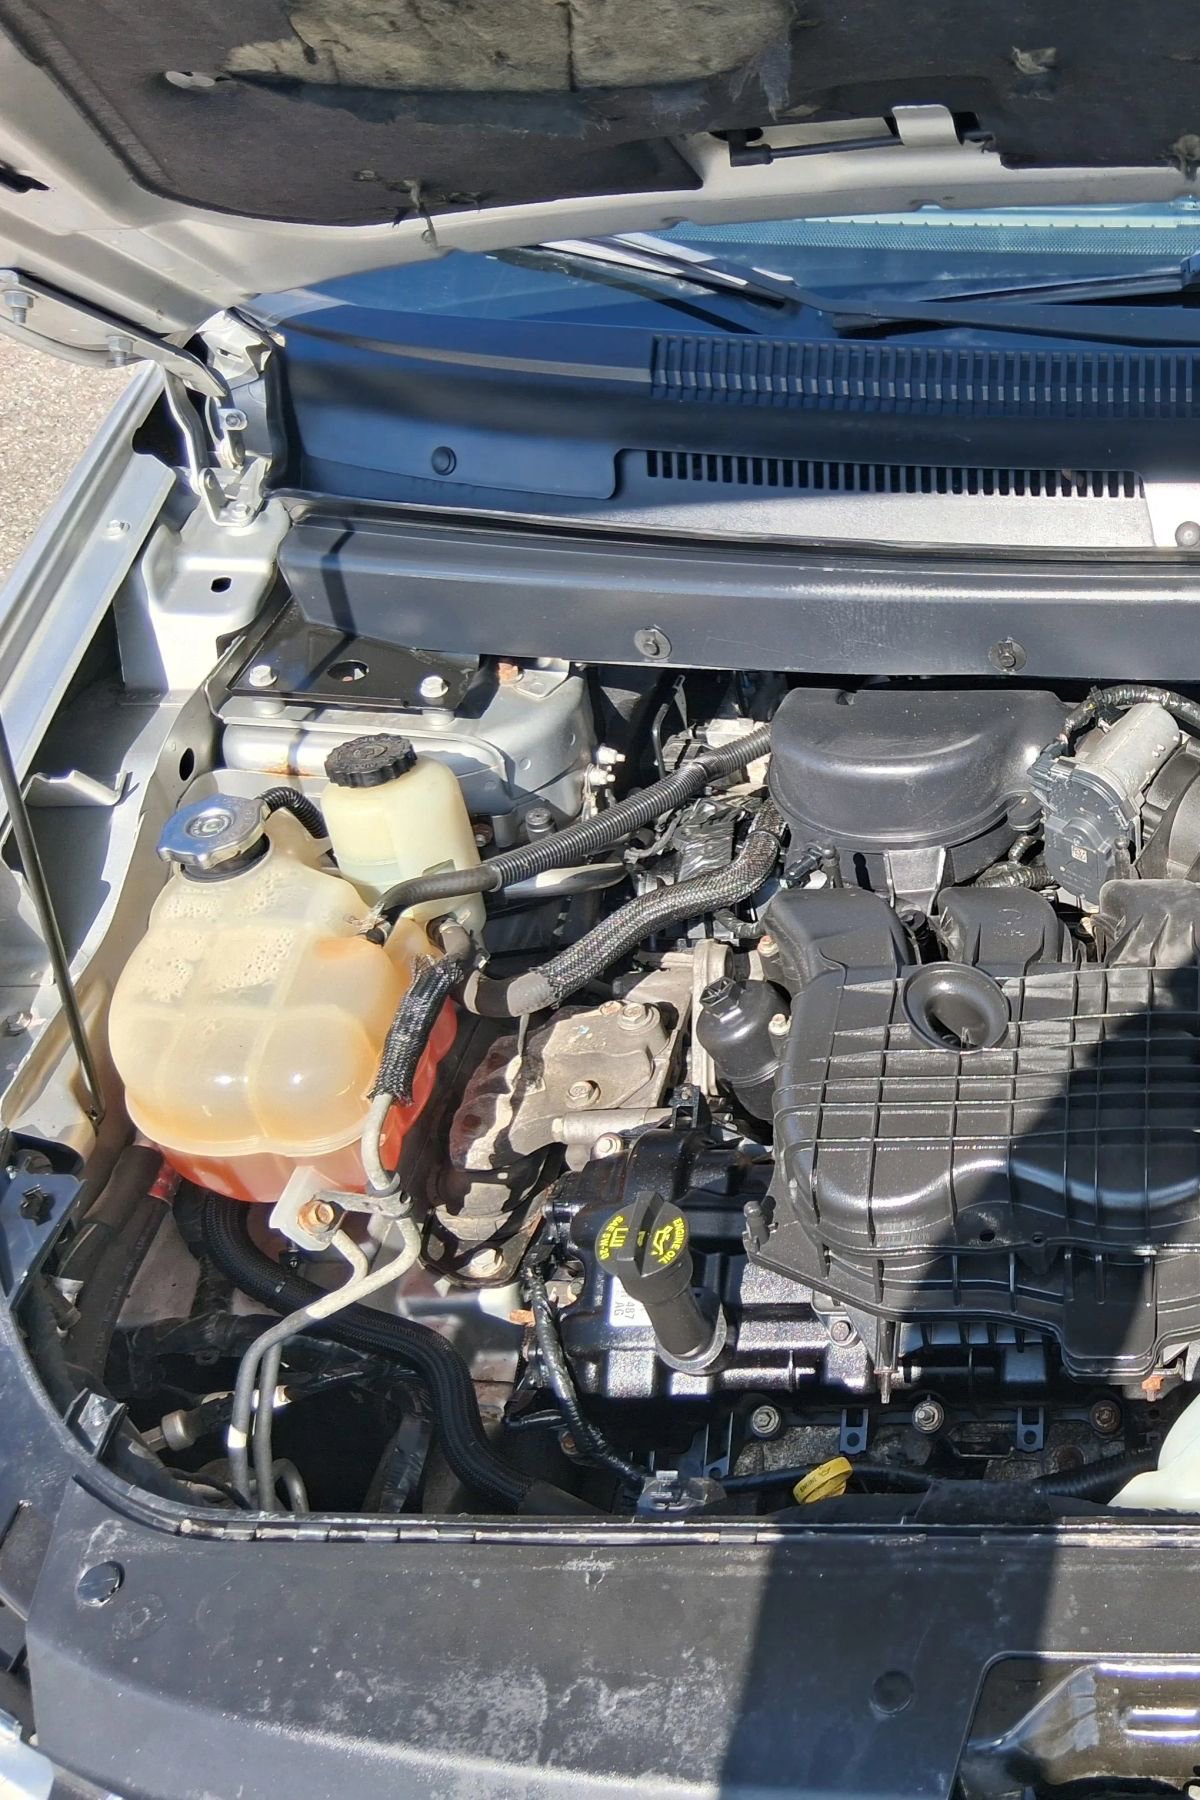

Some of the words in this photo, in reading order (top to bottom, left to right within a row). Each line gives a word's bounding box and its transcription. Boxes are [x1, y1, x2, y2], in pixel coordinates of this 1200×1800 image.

[606, 1216, 624, 1231] SAE
[673, 1217, 685, 1250] ENGINE
[600, 1233, 611, 1260] 5W-20
[658, 1250, 676, 1264] OIL
